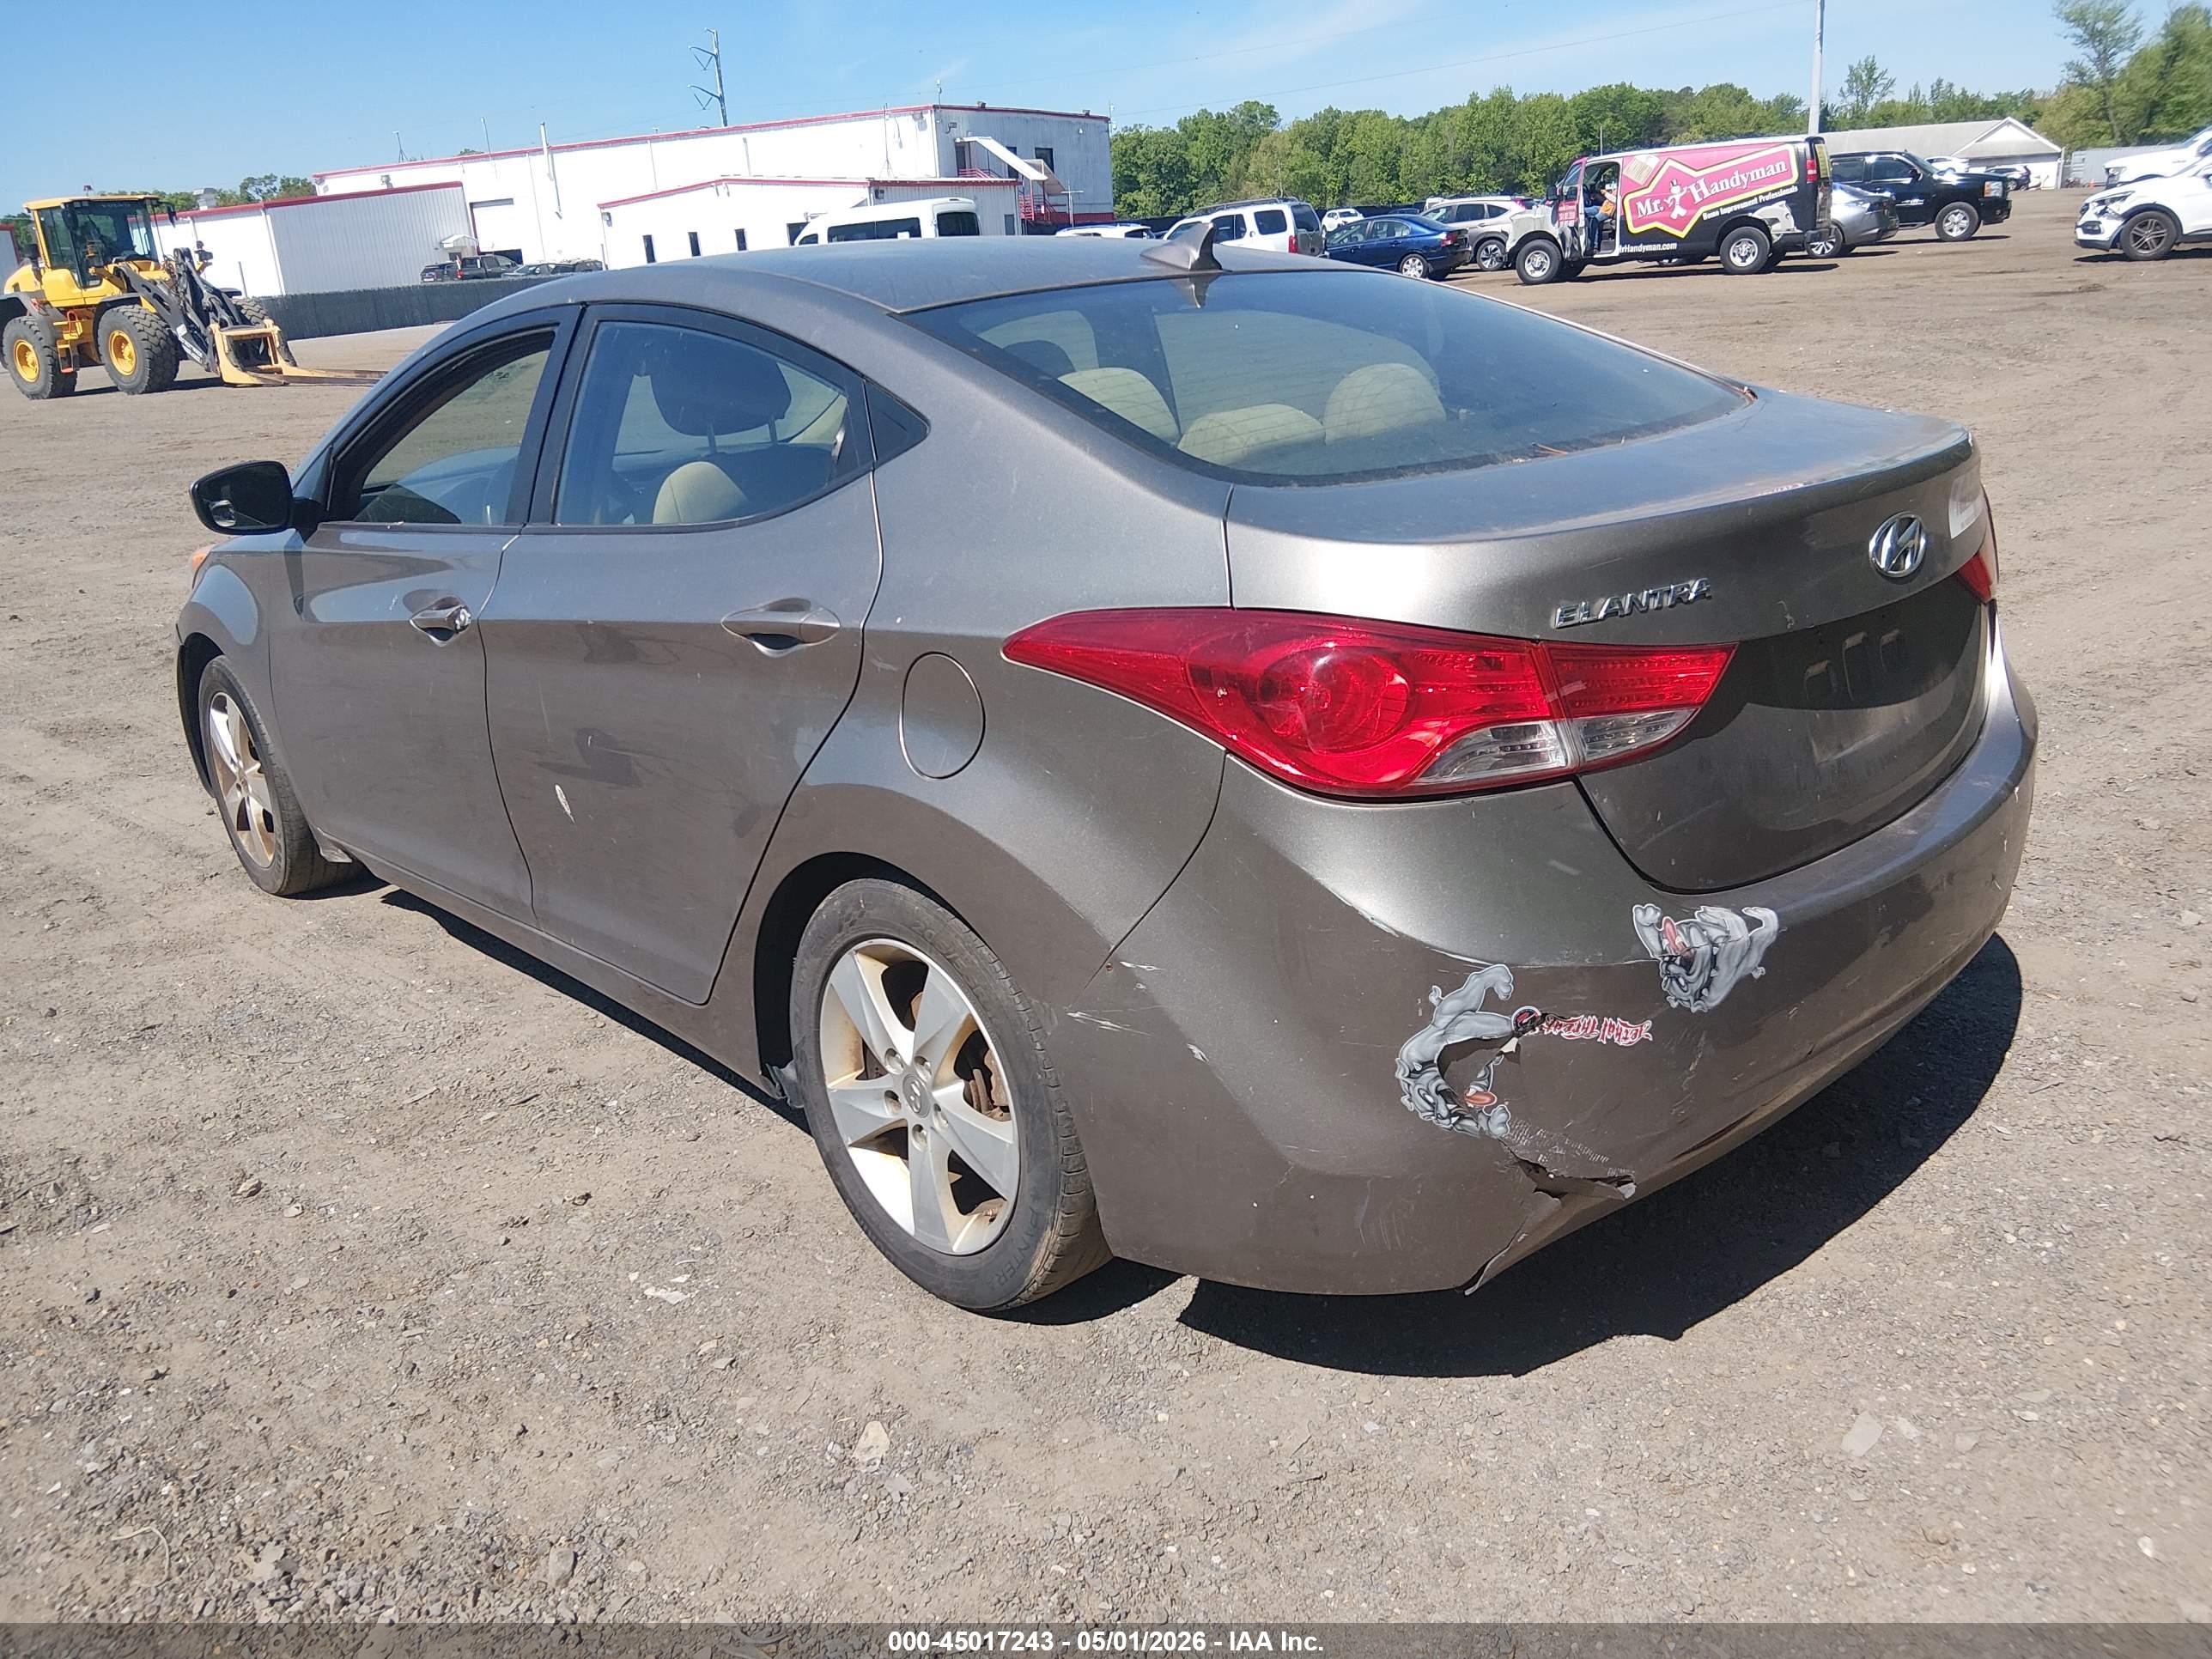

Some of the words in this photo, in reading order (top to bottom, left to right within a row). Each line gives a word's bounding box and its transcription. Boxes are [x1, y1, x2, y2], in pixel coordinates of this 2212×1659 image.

[1636, 198, 1664, 218] Mr.
[1687, 161, 1788, 204] Handyman
[1720, 198, 1759, 215] Improvement
[1759, 185, 1799, 203] Professionals
[1555, 578, 1712, 629] ELANTRA
